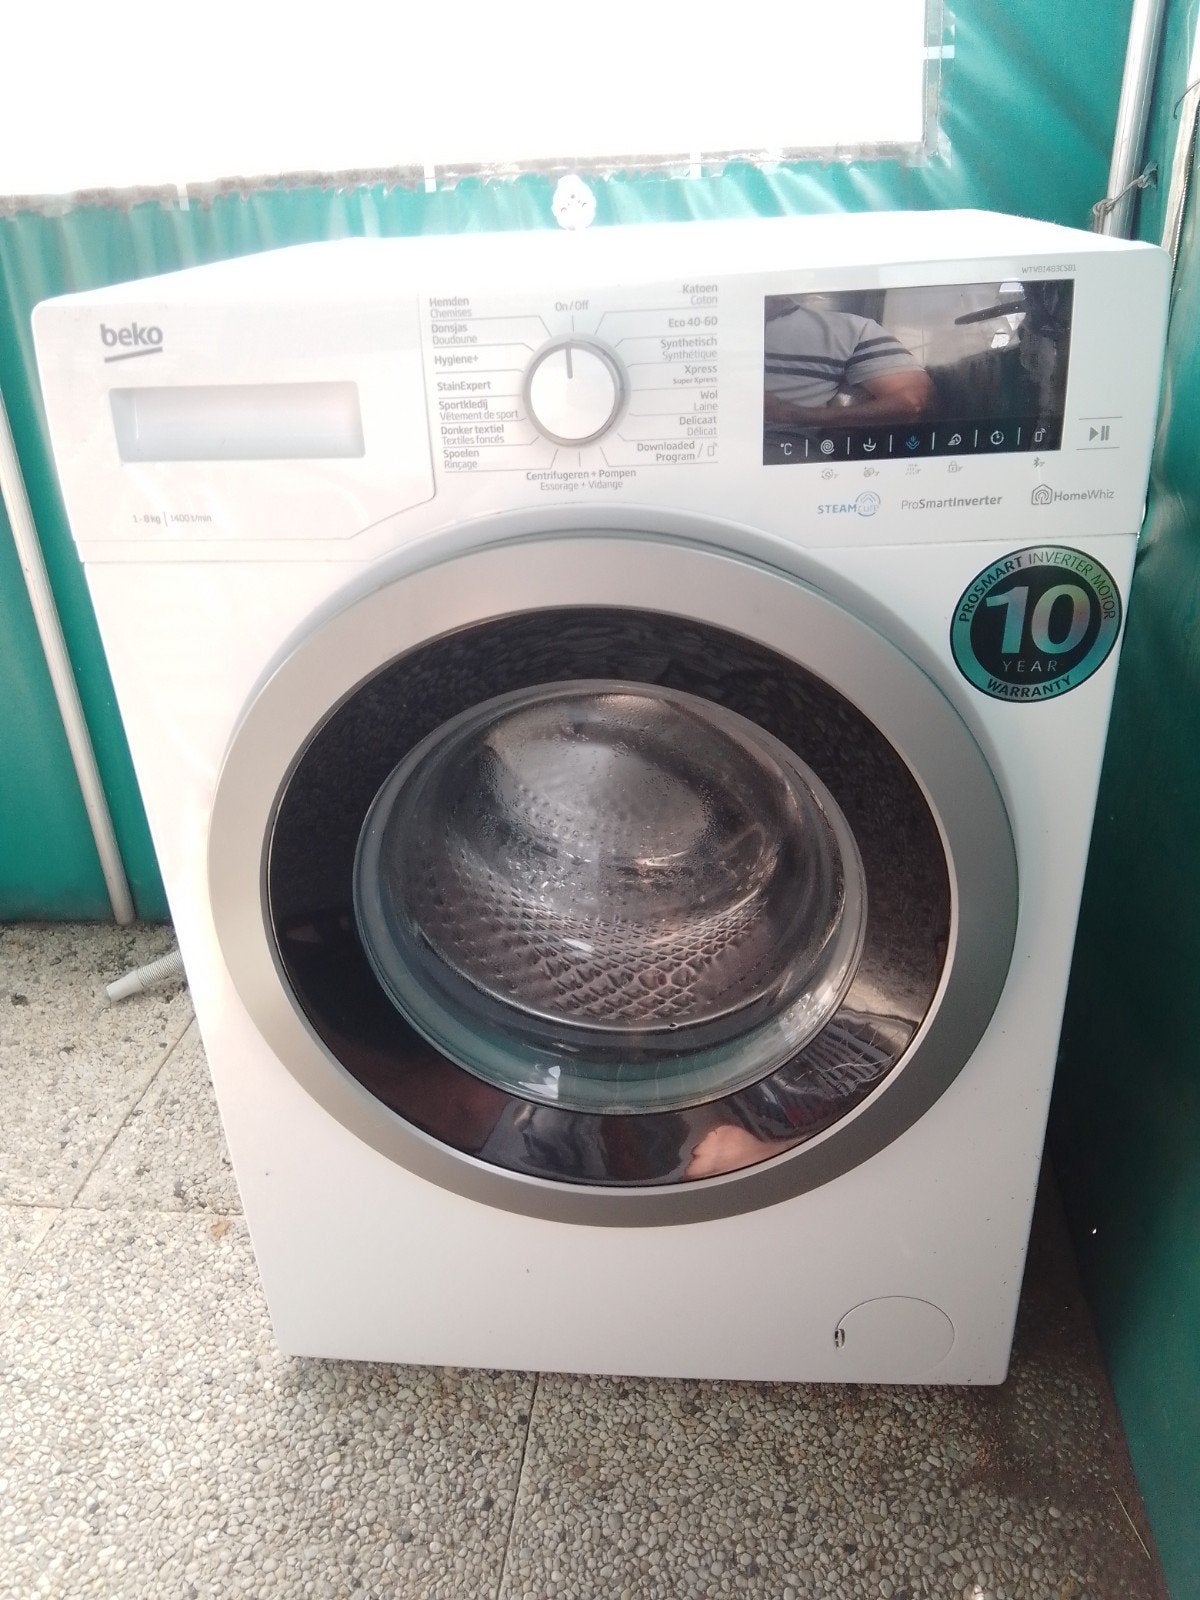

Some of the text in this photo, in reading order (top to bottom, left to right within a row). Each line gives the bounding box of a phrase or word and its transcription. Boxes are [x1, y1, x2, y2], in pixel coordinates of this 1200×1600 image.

[682, 284, 718, 294] Katoen
[429, 297, 470, 307] Hemden
[690, 295, 718, 305] Coton
[430, 308, 472, 318] Chemises
[668, 316, 718, 328] Eco 40-60
[431, 323, 468, 334] Donsjas
[100, 322, 163, 347] beko
[432, 335, 478, 345] Doudoune
[660, 337, 718, 350] Synthetisch
[434, 354, 479, 366] Hygiene+
[684, 365, 718, 375] Xpress
[437, 381, 491, 392] StainExpert
[672, 377, 693, 386] Super
[700, 390, 718, 400] Wol
[438, 399, 488, 411] Sportkledij
[693, 402, 718, 411] Laine
[483, 410, 493, 419] de
[496, 409, 519, 420] sport
[679, 416, 718, 426] Delicaat
[440, 424, 505, 436] Donker textiel
[442, 435, 475, 446] Textiles
[637, 441, 696, 452] Downloaded
[443, 448, 480, 459] Spoelen
[656, 453, 696, 464] Program
[444, 460, 478, 471] Rinçage
[526, 471, 590, 481] Centrifugeren
[599, 469, 637, 480] Pompen
[540, 481, 579, 491] Essorage
[588, 480, 623, 490] Vidange
[1054, 488, 1115, 502] HomeWhiz
[901, 494, 1003, 510] ProSmartInverter
[959, 551, 1117, 623] PROSMART INVERTER MOTOR
[986, 584, 1092, 655] 10
[1002, 660, 1059, 673] YEAR
[986, 674, 1073, 698] WARRANTY
